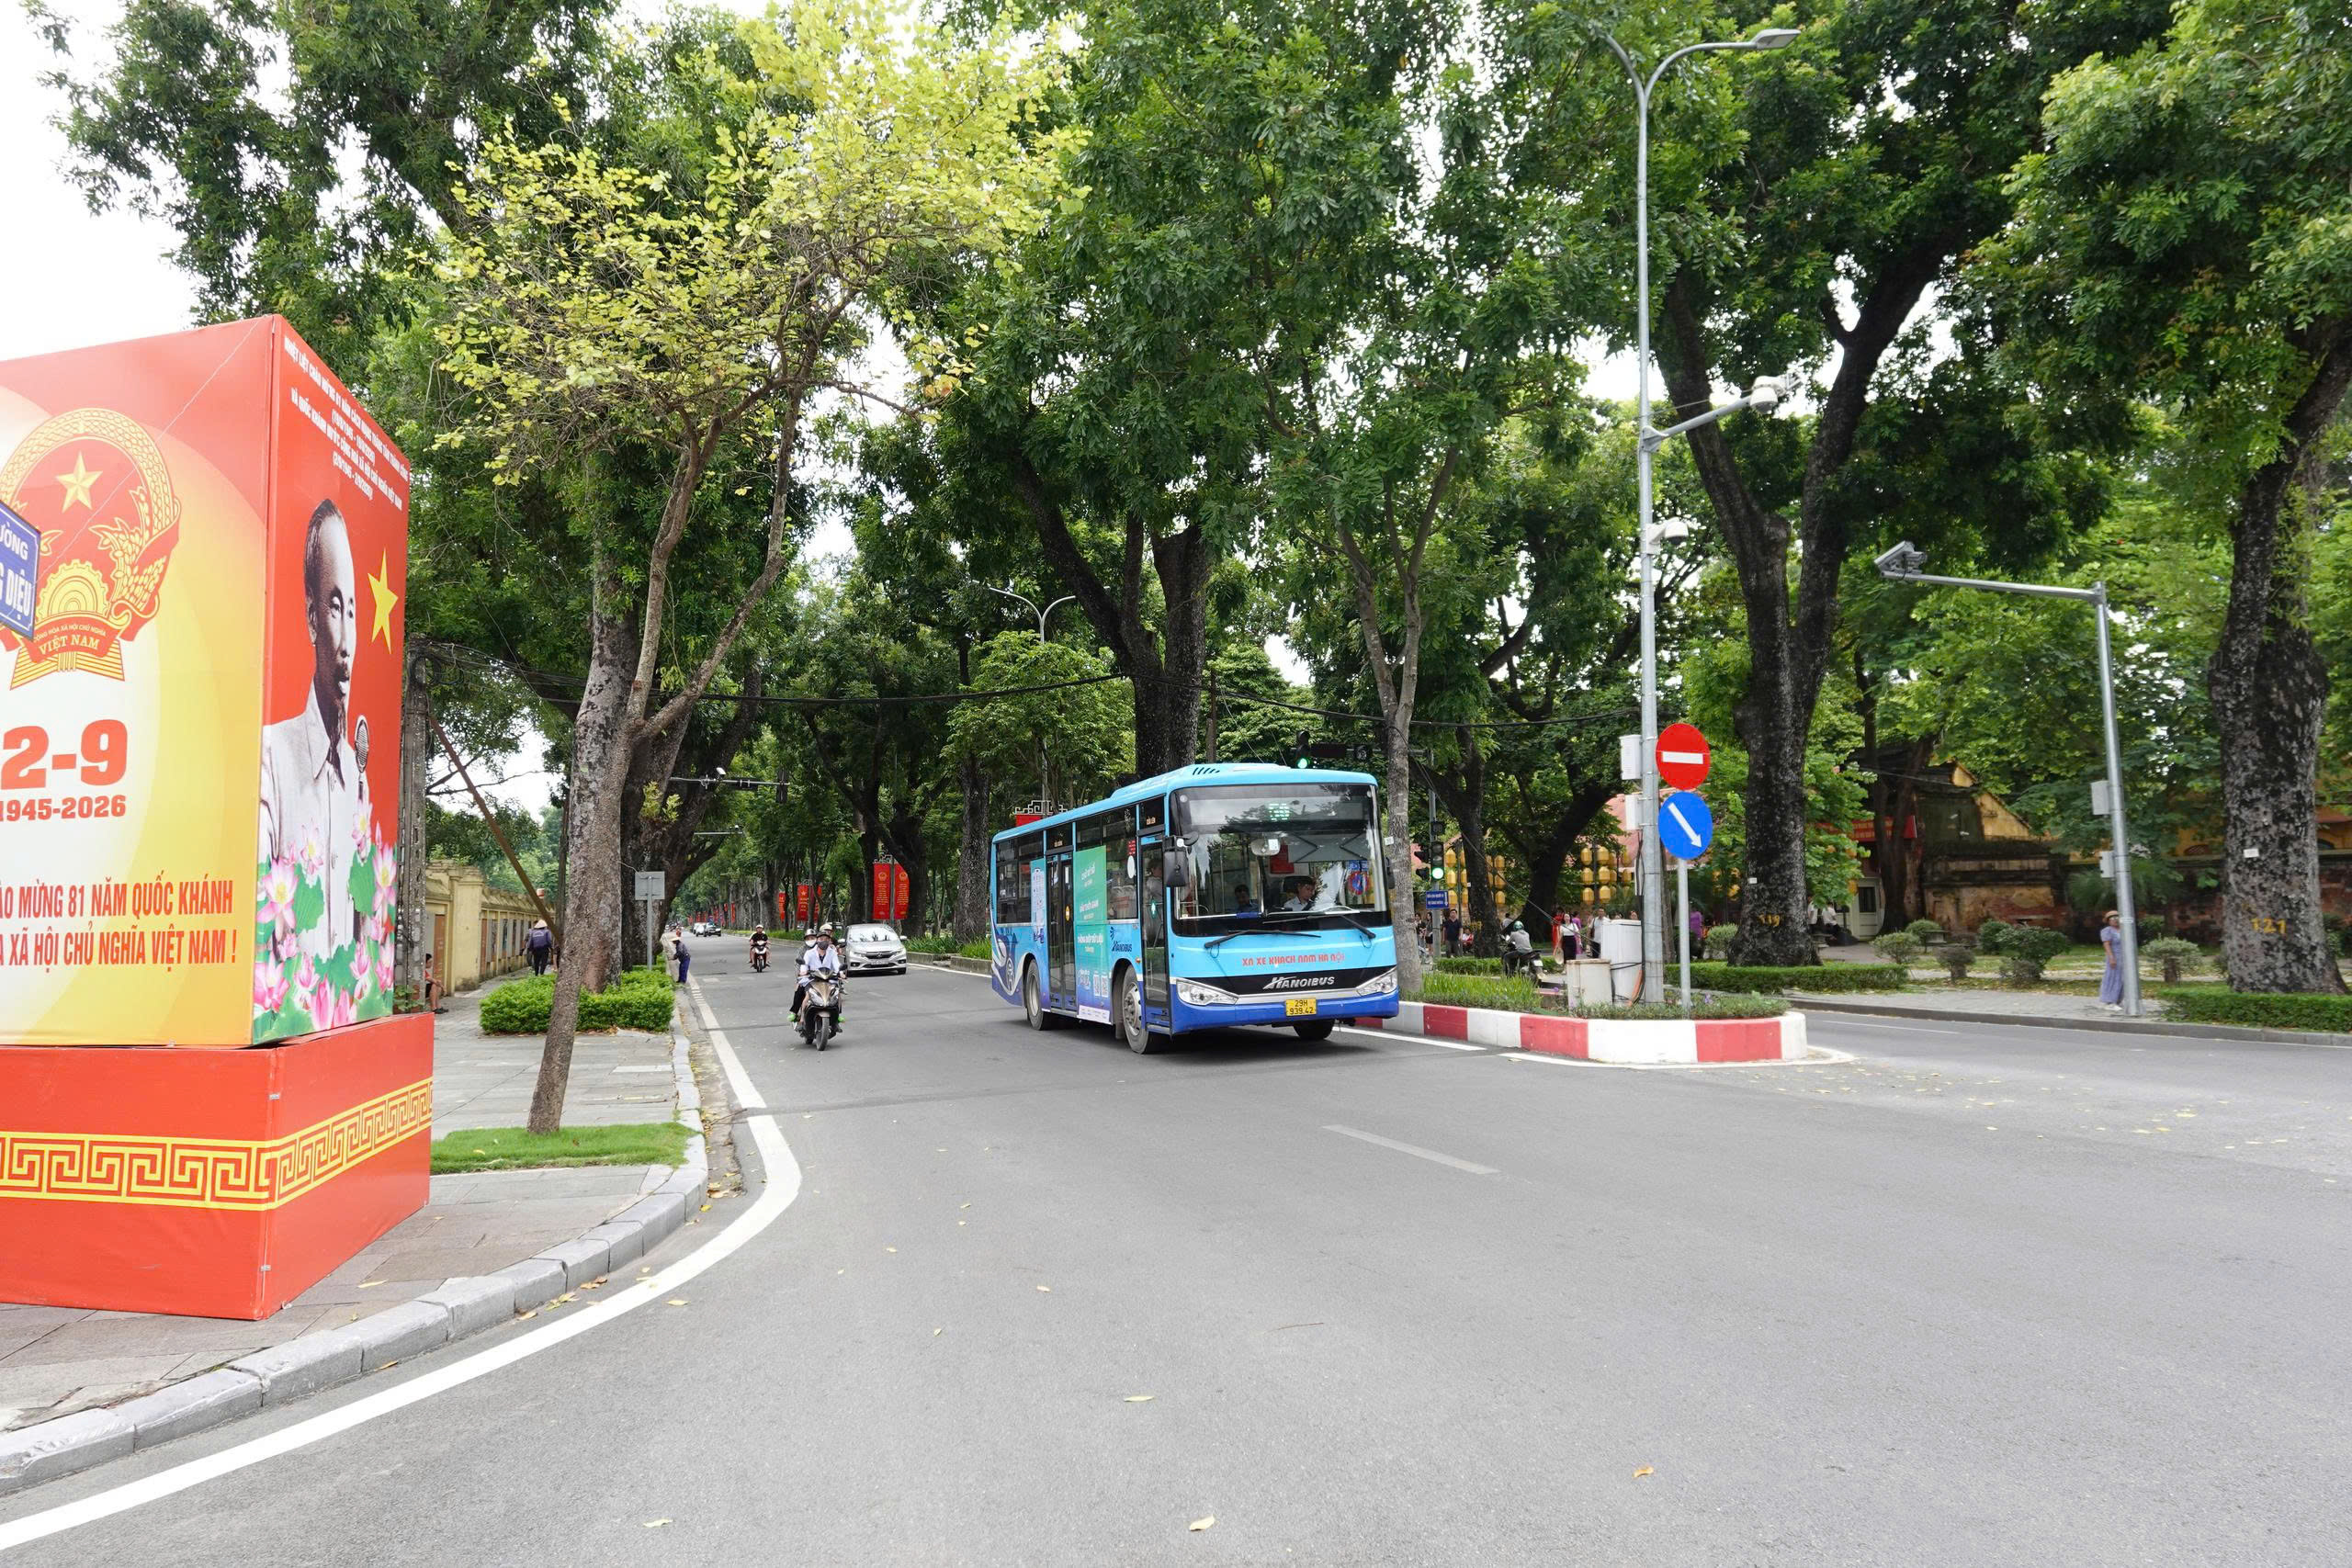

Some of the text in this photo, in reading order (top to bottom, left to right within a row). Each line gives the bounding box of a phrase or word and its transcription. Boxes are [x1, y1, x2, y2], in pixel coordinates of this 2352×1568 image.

[6, 568, 32, 620] DIỆU
[39, 634, 100, 655] VIỆT NAM
[1, 719, 128, 790] 2-9
[18, 878, 63, 919] MỪNG
[68, 885, 85, 918] 81
[91, 876, 127, 917] NĂM
[132, 870, 174, 919] QUỐC
[177, 874, 233, 916] KHÁNH
[8, 926, 28, 965] XÃ
[34, 925, 59, 973] HỘI
[63, 920, 94, 965] CHỦ
[98, 924, 146, 964] NGHĨA
[152, 923, 185, 972] VIỆT
[188, 930, 226, 964] NAM
[1262, 976, 1335, 989] HANOIBUS
[1289, 1007, 1315, 1015] 939.42
[1295, 999, 1308, 1008] 29H
